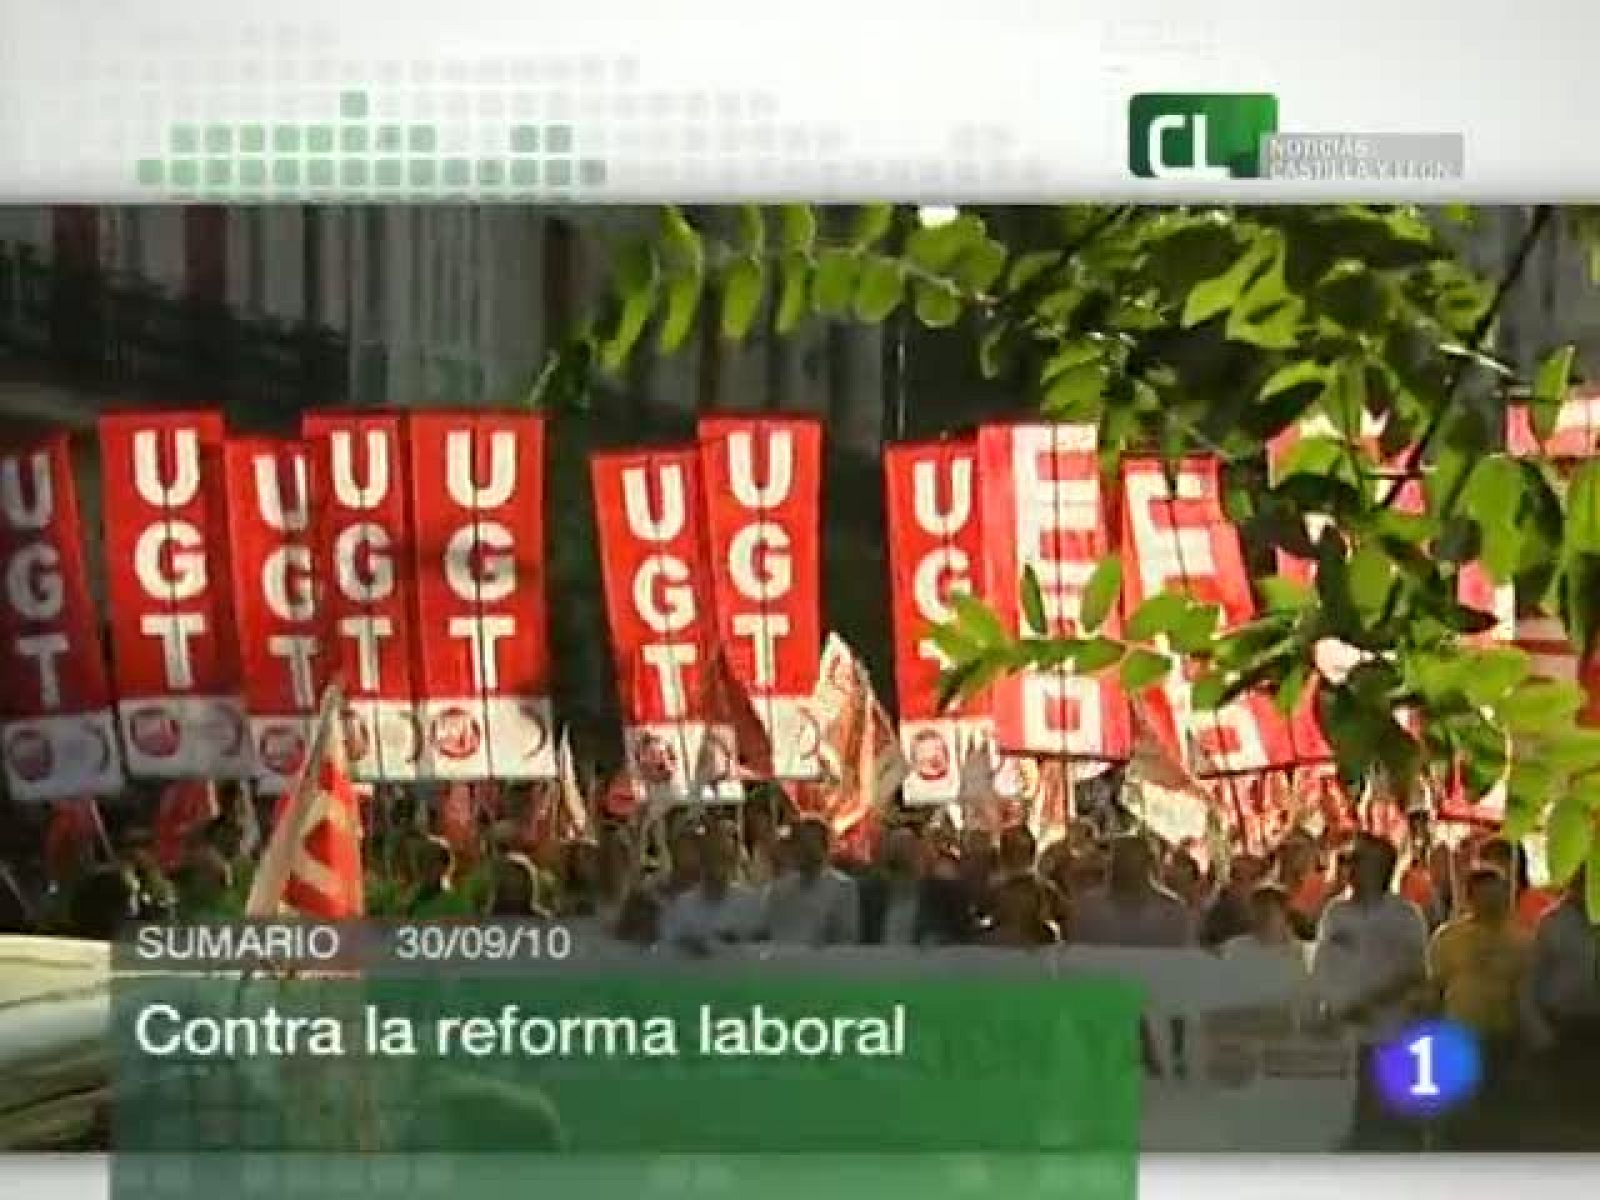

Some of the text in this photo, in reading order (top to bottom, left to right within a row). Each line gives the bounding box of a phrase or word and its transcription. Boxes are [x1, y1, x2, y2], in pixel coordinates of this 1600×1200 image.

[2, 454, 70, 707] UGT
[133, 429, 208, 689] UGT
[254, 454, 319, 708] UGT
[331, 430, 396, 692] UGT
[444, 430, 518, 691] UGT
[621, 464, 698, 718] UGT
[726, 430, 793, 687] UGT
